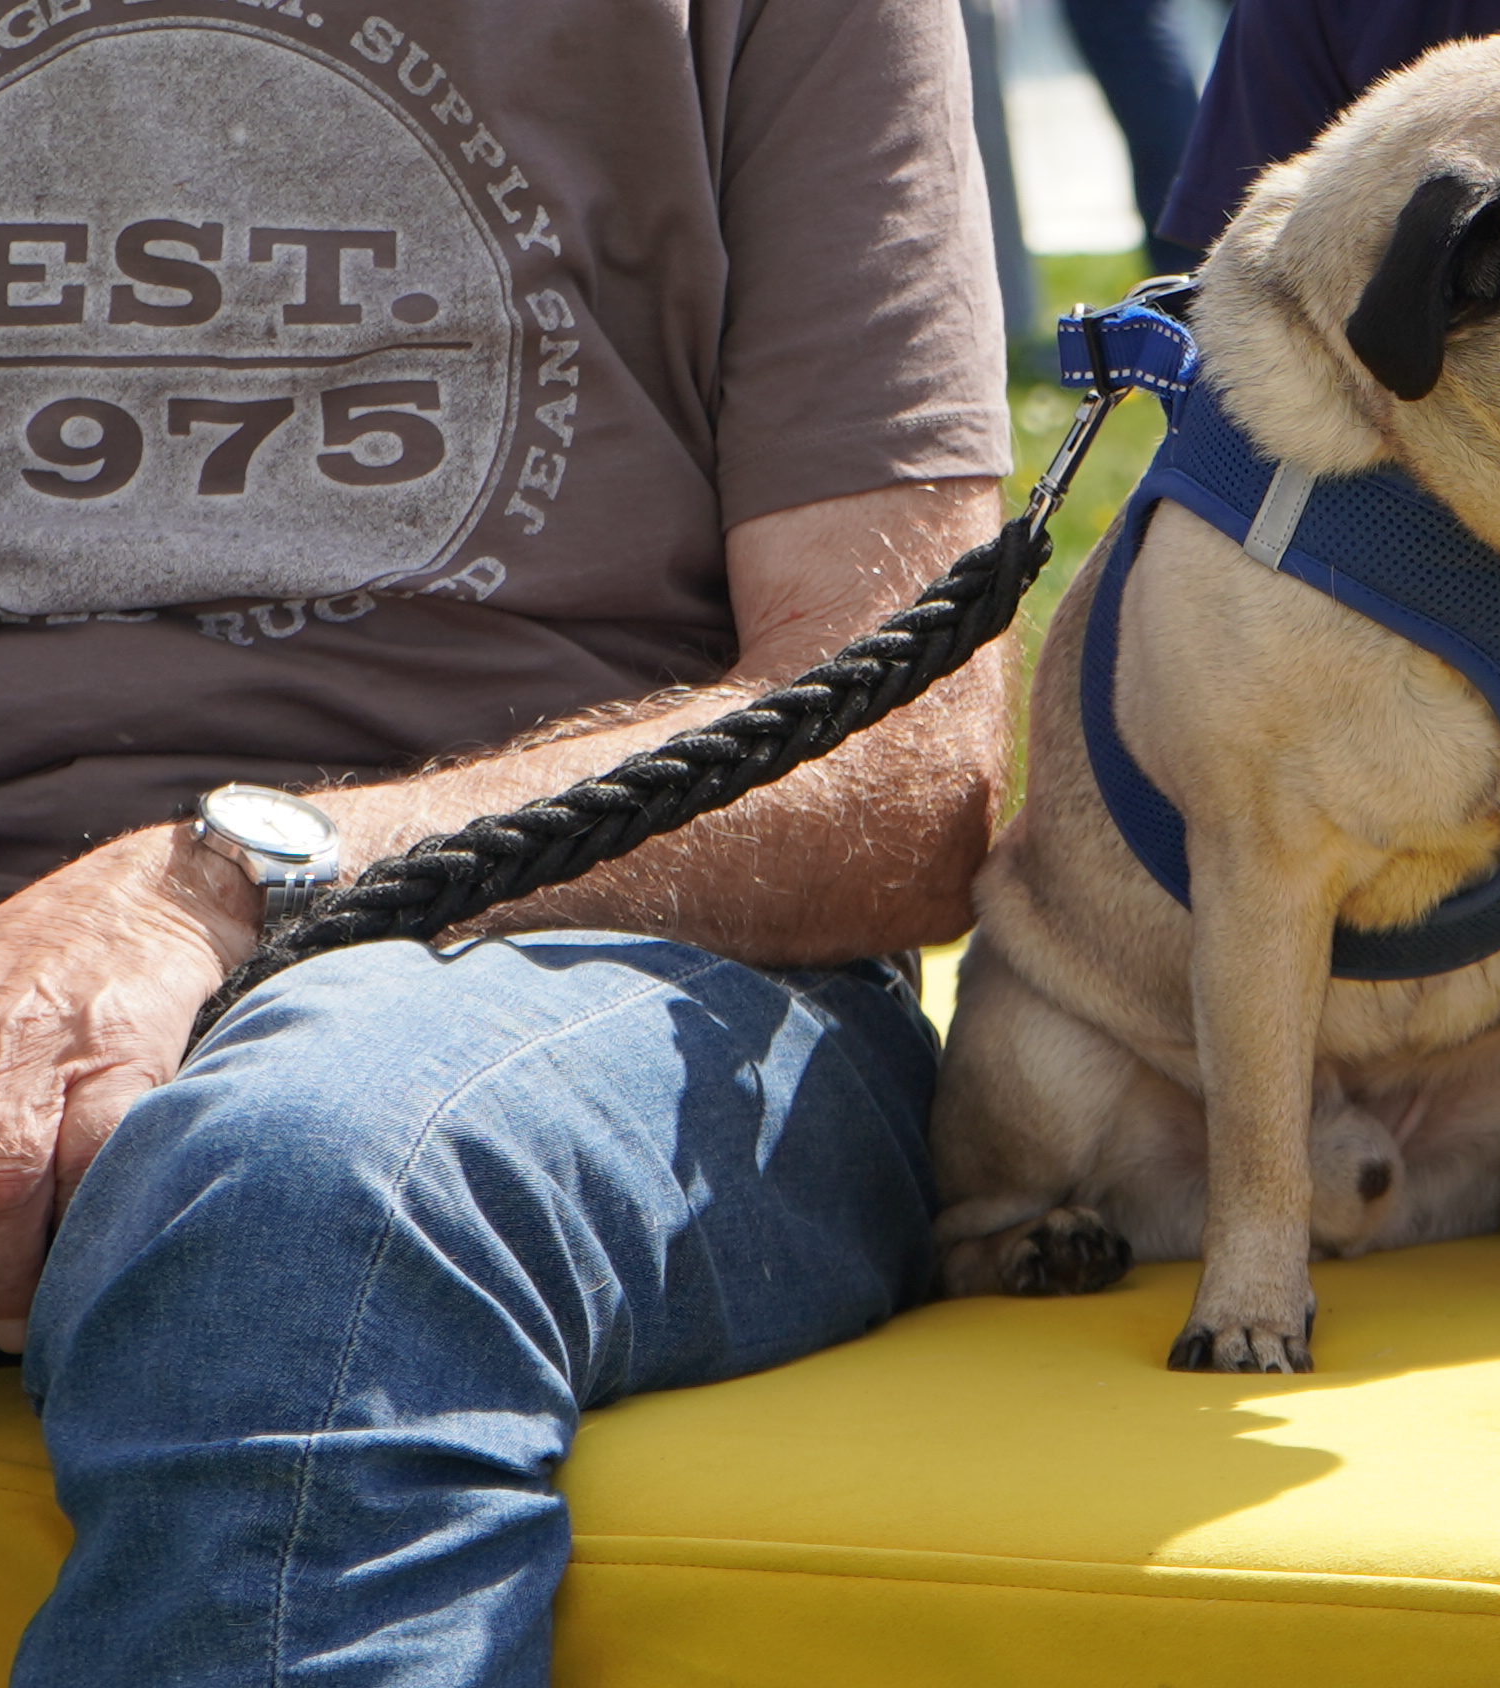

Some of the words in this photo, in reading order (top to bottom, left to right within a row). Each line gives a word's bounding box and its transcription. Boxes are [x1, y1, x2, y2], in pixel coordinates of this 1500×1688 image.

[349, 15, 562, 258] SUPPLY
[195, 555, 507, 647] RUGD
[503, 287, 581, 536] JEANS
